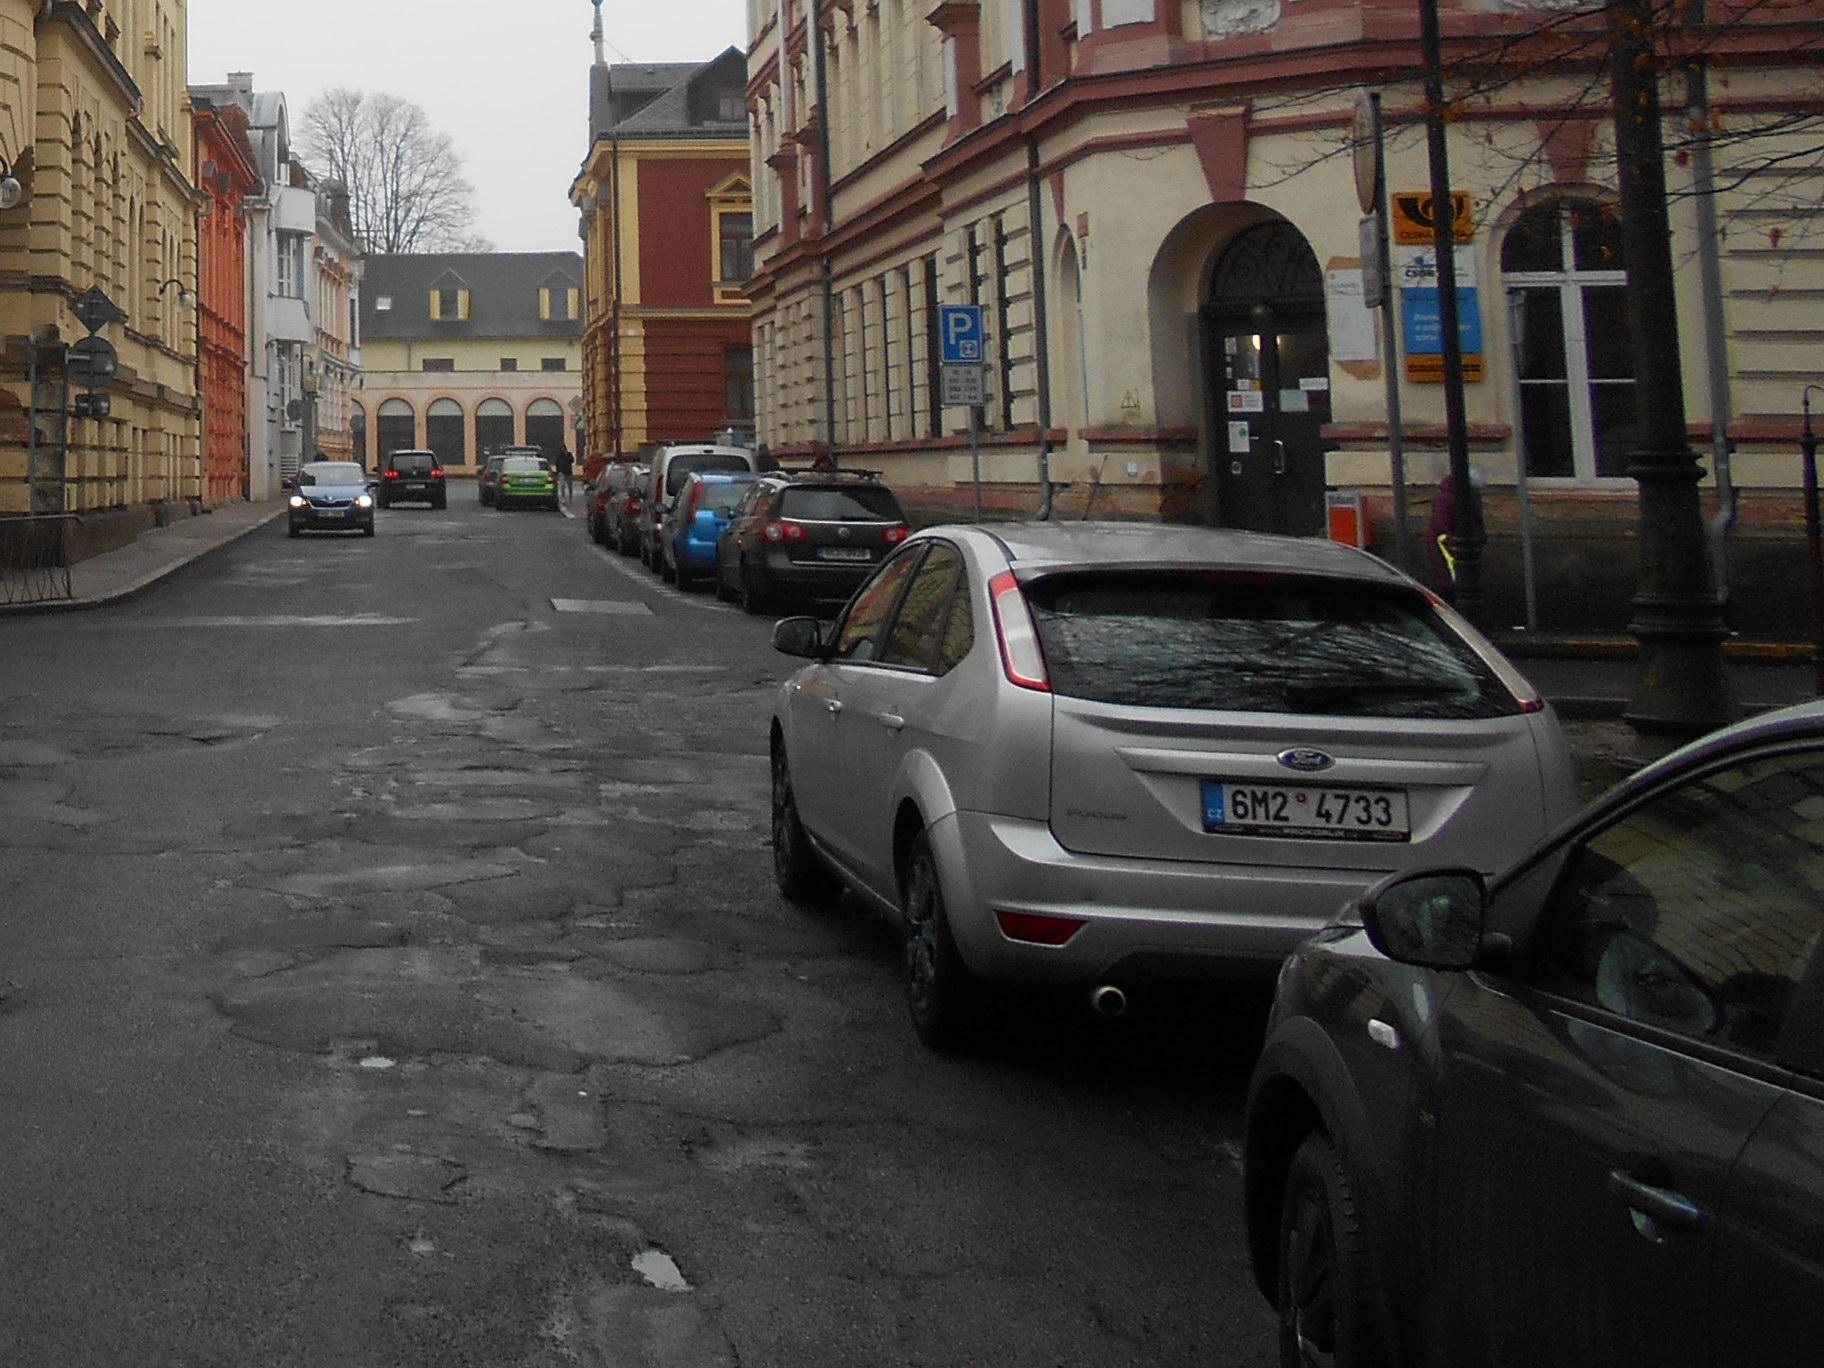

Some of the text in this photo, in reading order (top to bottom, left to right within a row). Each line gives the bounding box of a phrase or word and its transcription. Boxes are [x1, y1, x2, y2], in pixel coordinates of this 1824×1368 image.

[948, 312, 973, 345] P
[1207, 808, 1223, 820] CZ
[1231, 789, 1393, 827] 6M2 4733
